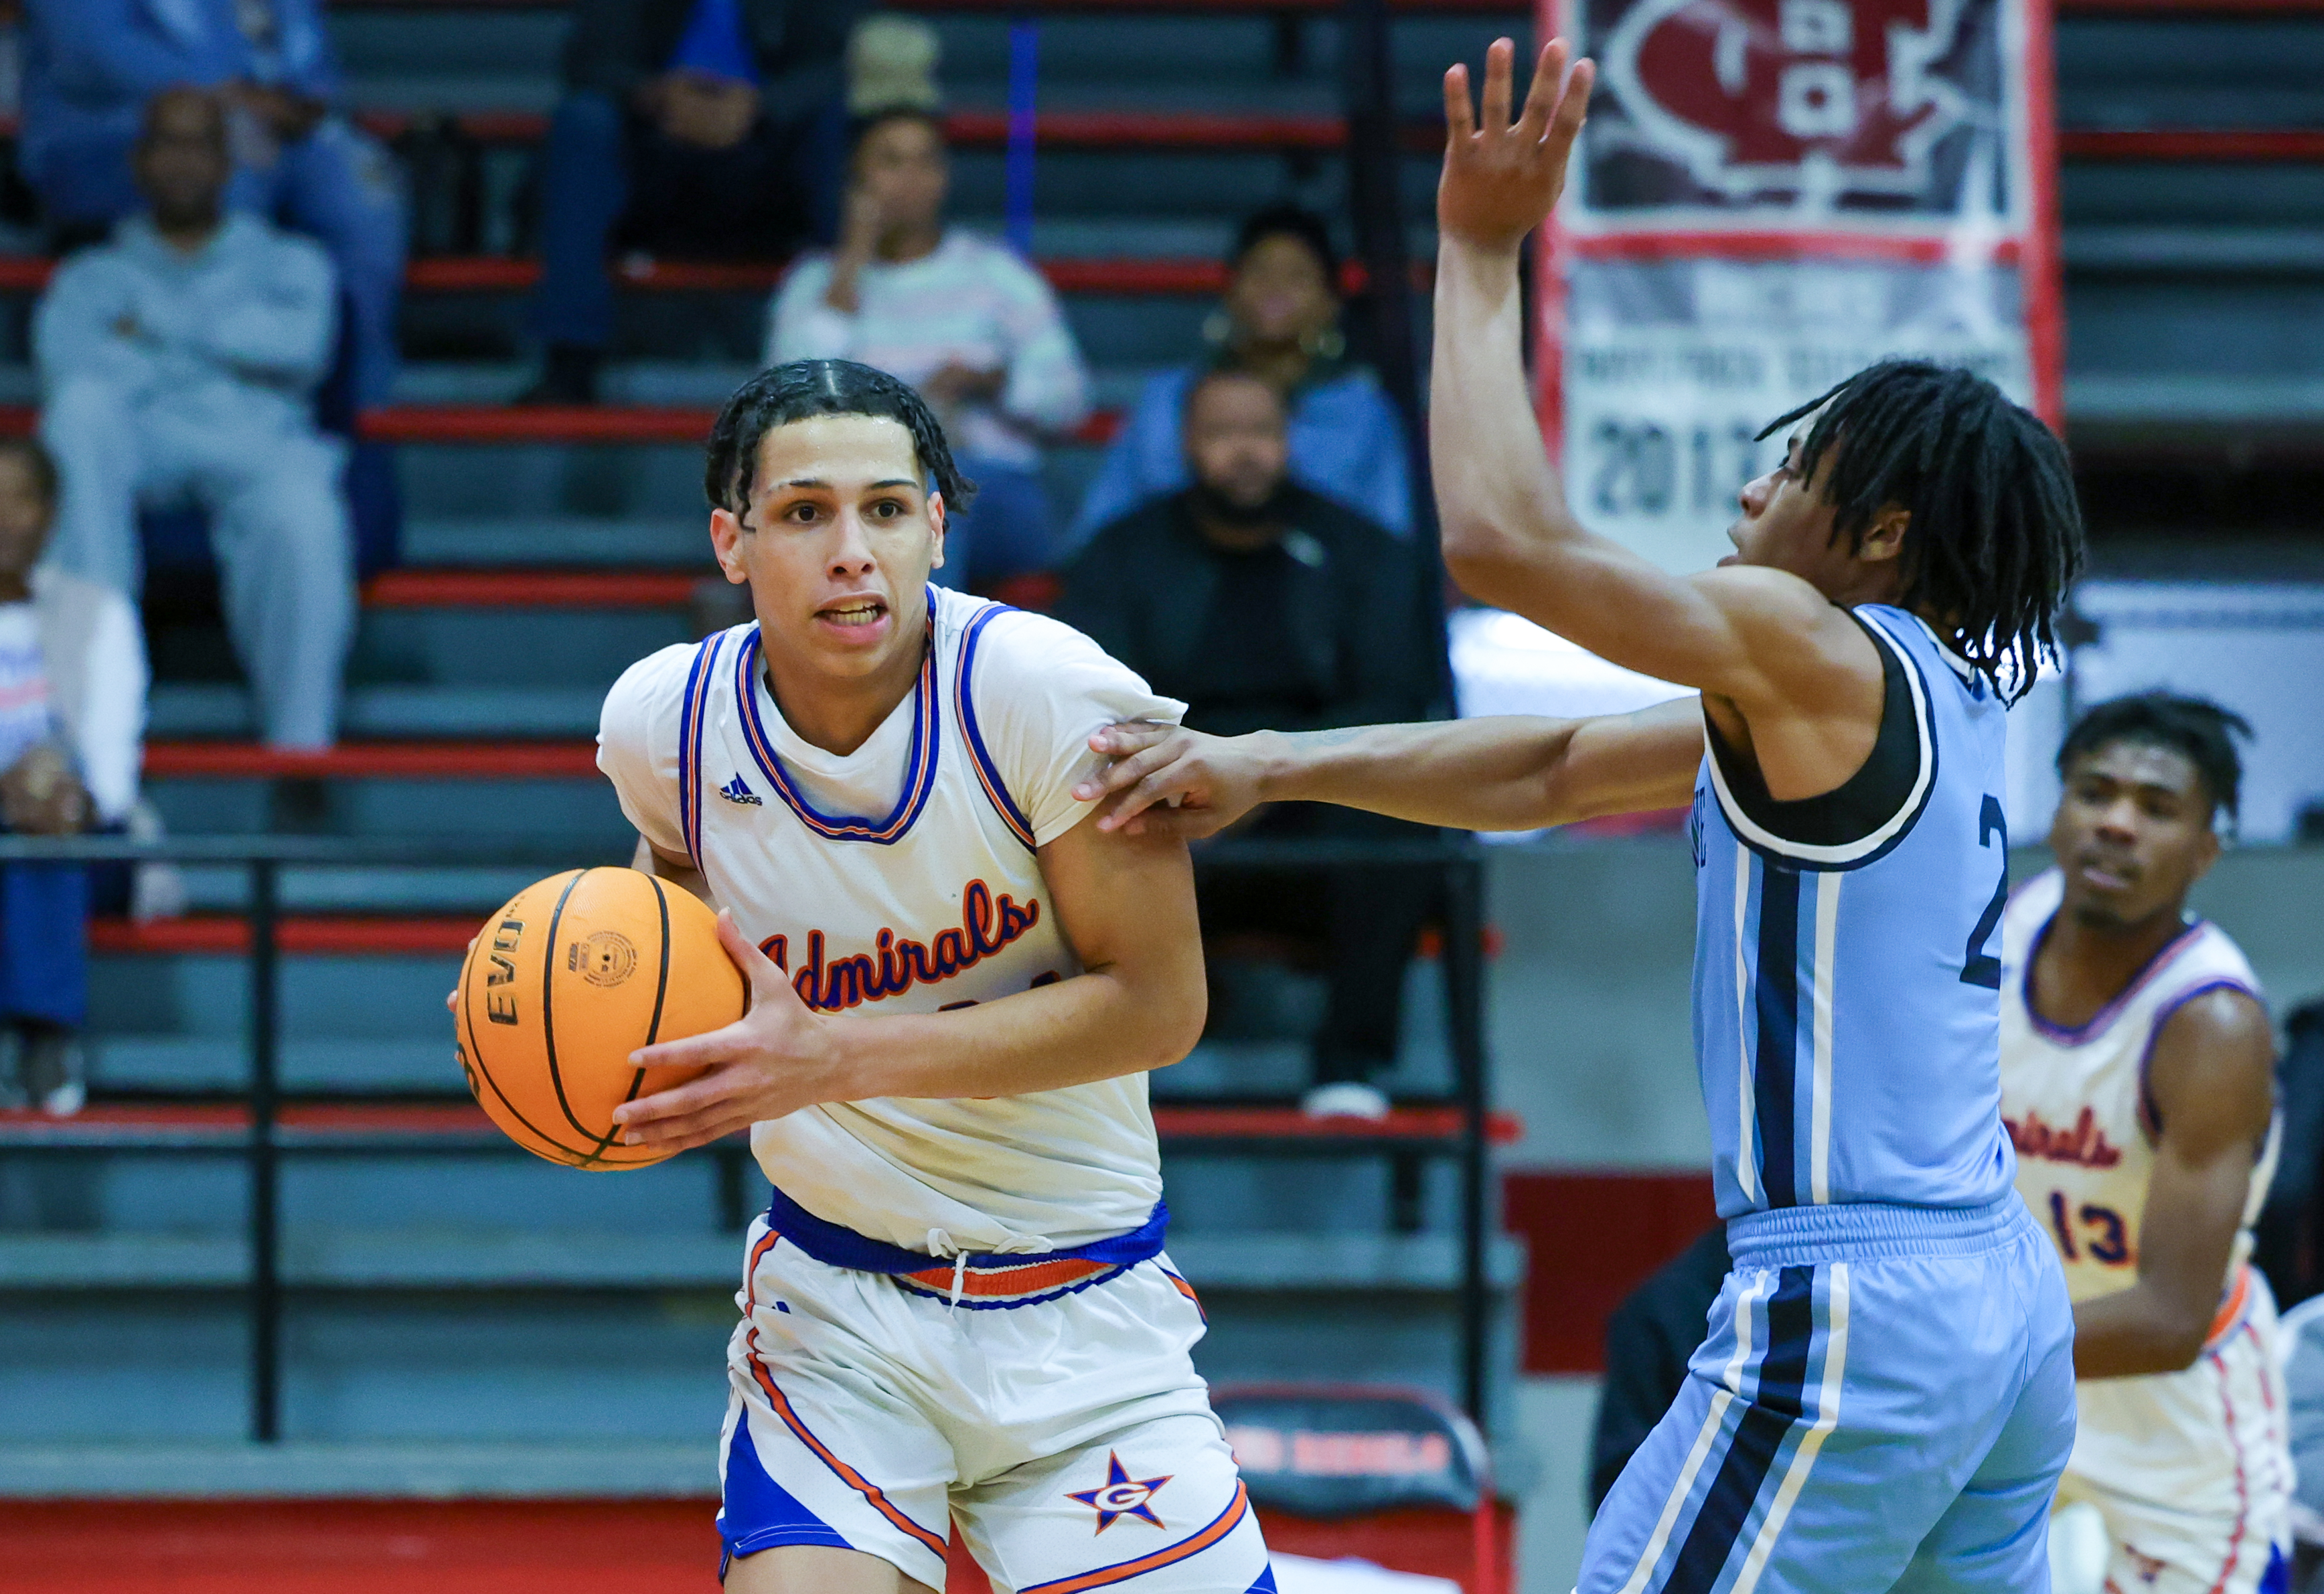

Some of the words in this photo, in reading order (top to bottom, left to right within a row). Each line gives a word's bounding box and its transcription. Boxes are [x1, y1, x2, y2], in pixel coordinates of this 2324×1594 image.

[1960, 793, 2008, 989] 2
[487, 919, 525, 1025] EVO
[2050, 1192, 2131, 1265] 13
[1095, 1482, 1150, 1512] G
